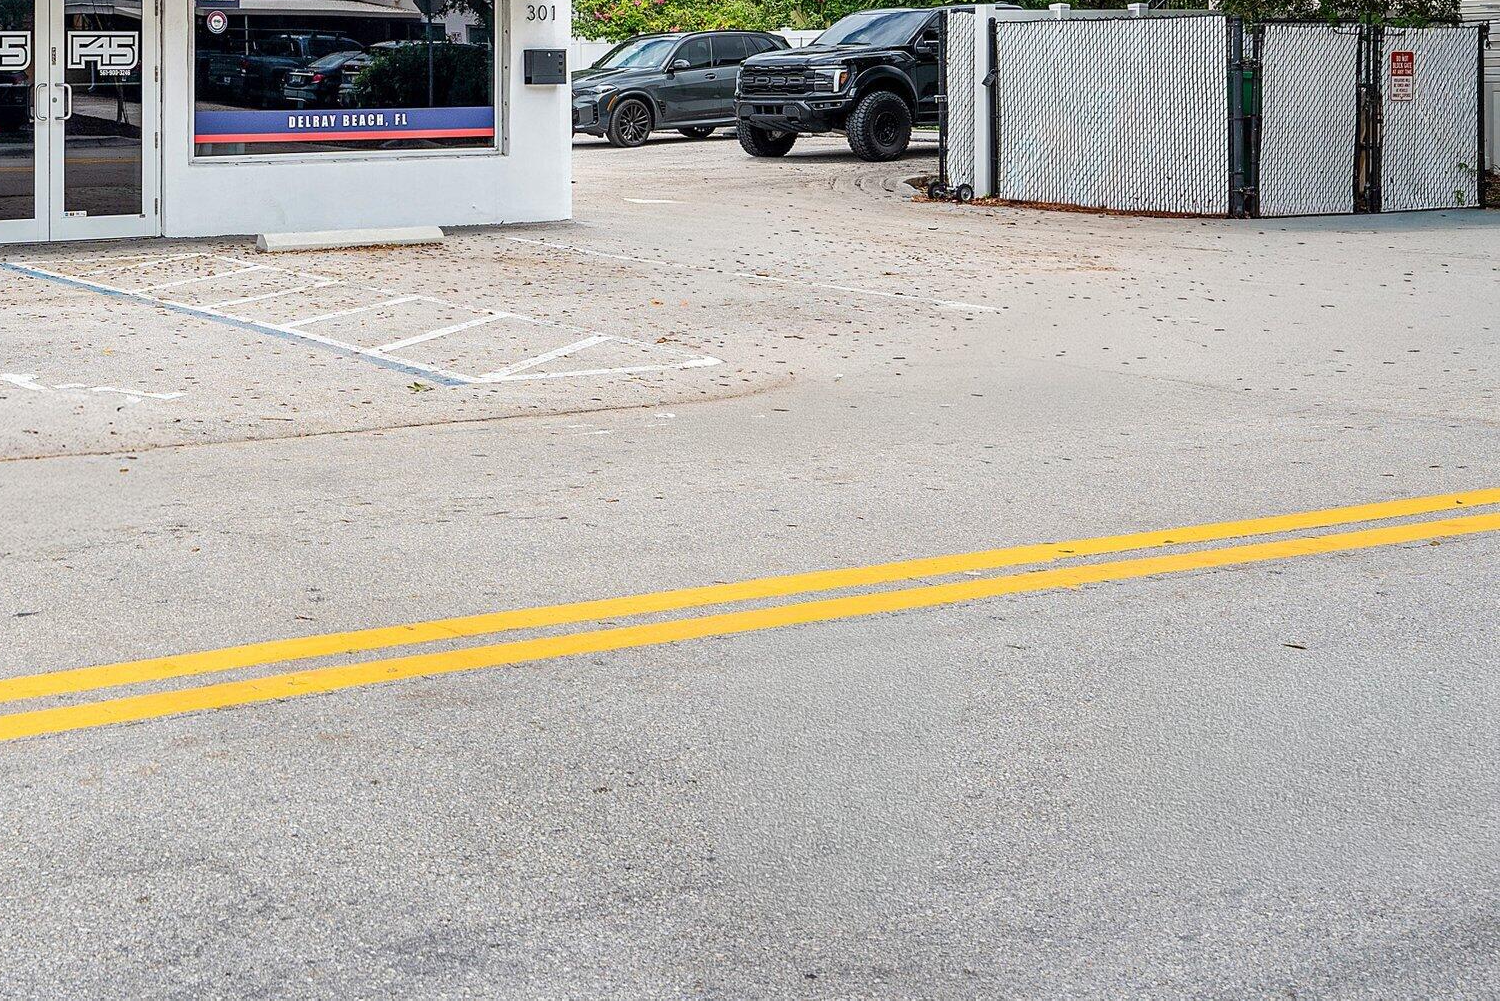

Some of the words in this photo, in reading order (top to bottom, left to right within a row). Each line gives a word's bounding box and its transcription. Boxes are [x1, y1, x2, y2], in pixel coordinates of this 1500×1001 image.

[527, 5, 555, 21] 301
[70, 33, 136, 67] F45
[288, 115, 336, 128] DELRAY
[342, 113, 389, 127] BEACH,
[395, 113, 408, 126] FL
